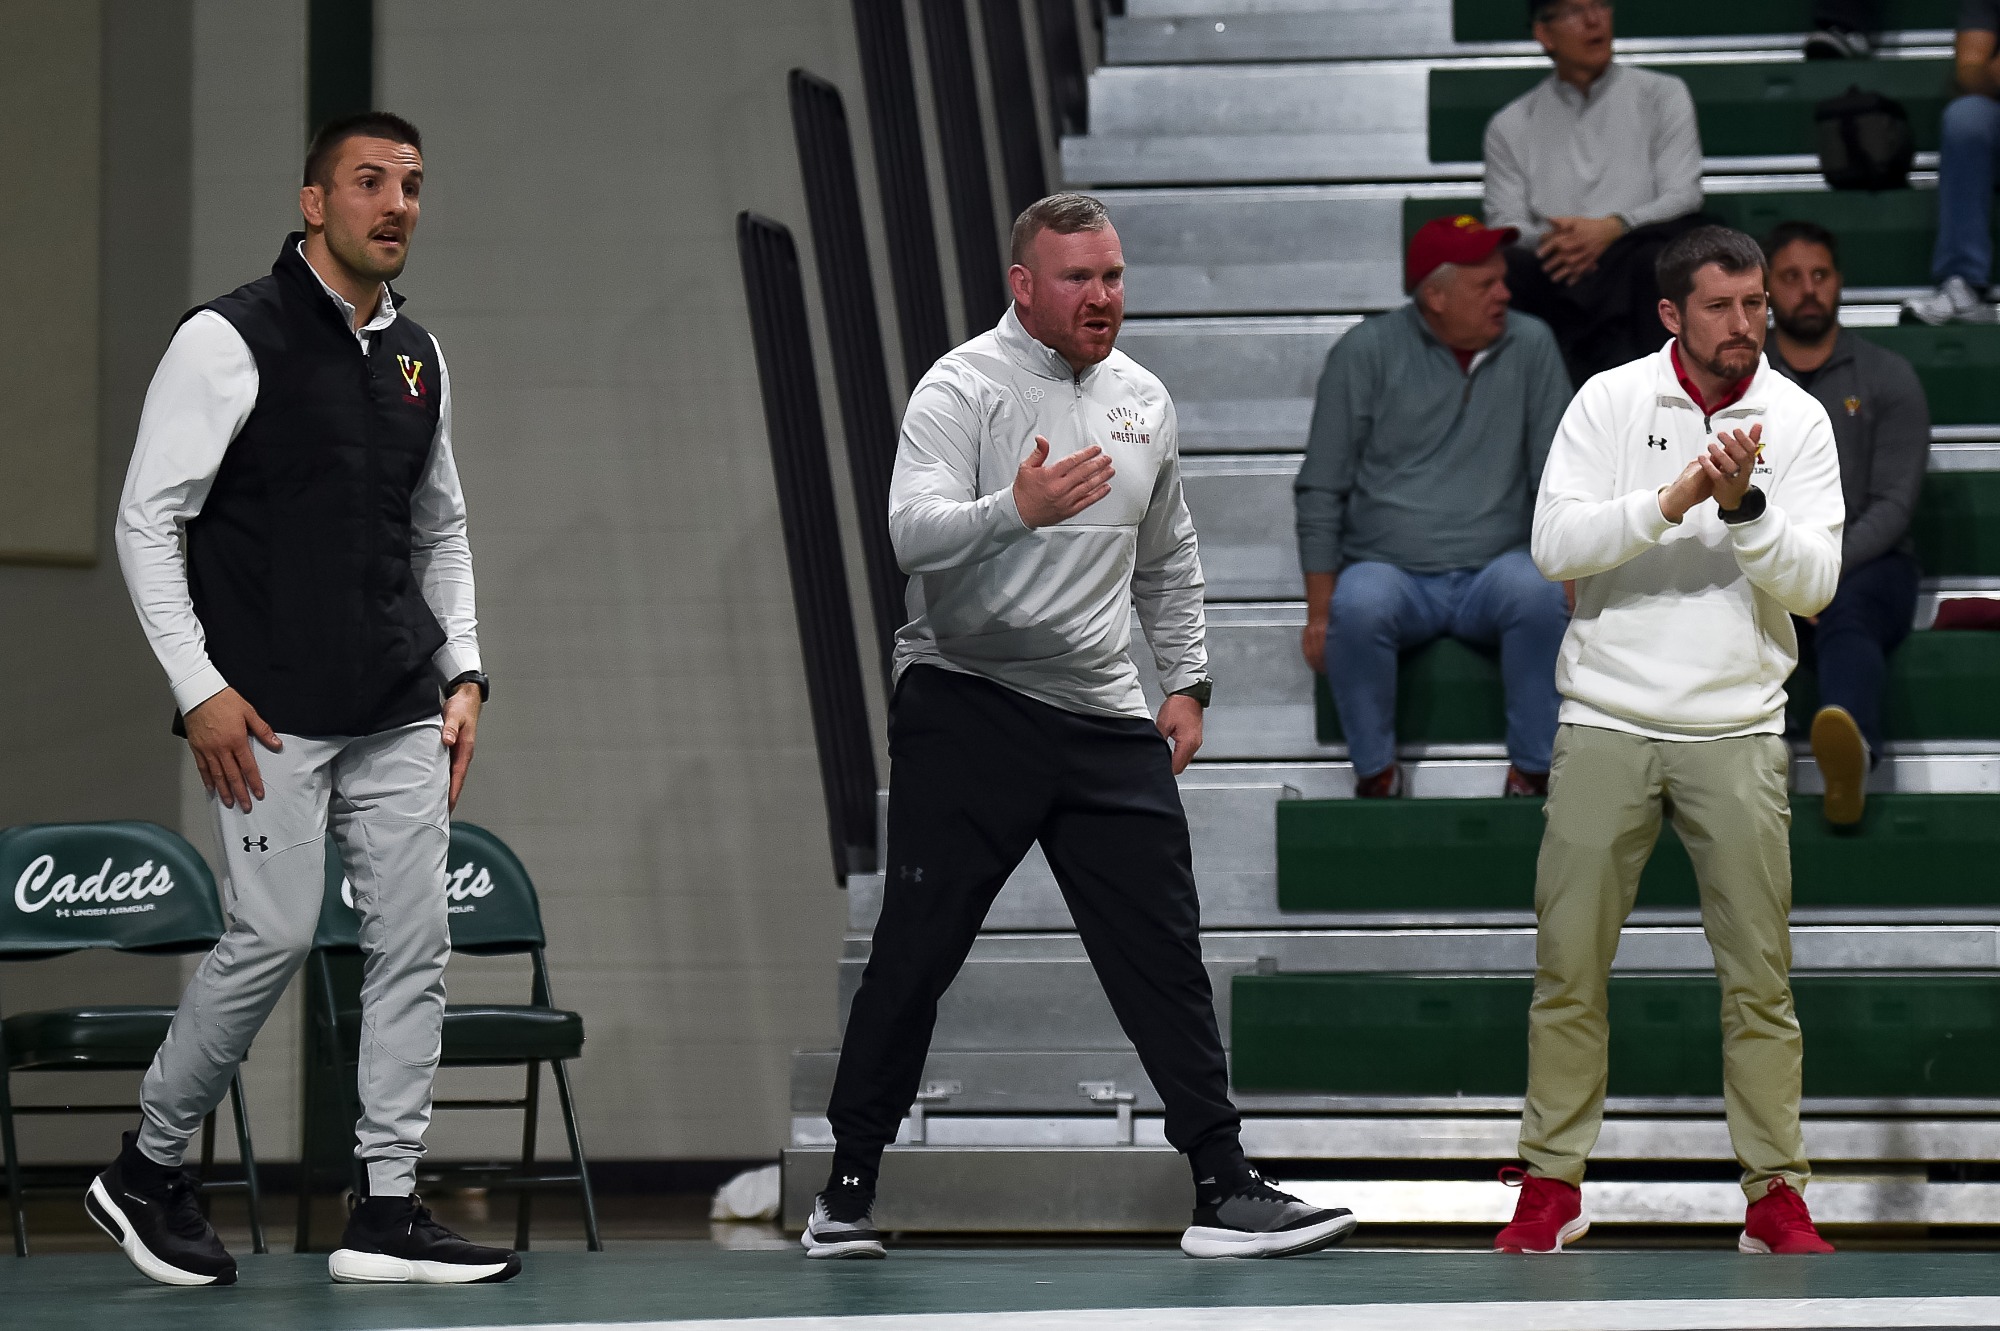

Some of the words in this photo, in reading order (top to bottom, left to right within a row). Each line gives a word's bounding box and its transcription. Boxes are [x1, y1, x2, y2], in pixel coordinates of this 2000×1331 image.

[1110, 430, 1150, 444] WRESTLING
[14, 854, 174, 913] Cadets
[72, 907, 107, 917] UNDER
[108, 903, 155, 915] ARMOUR
